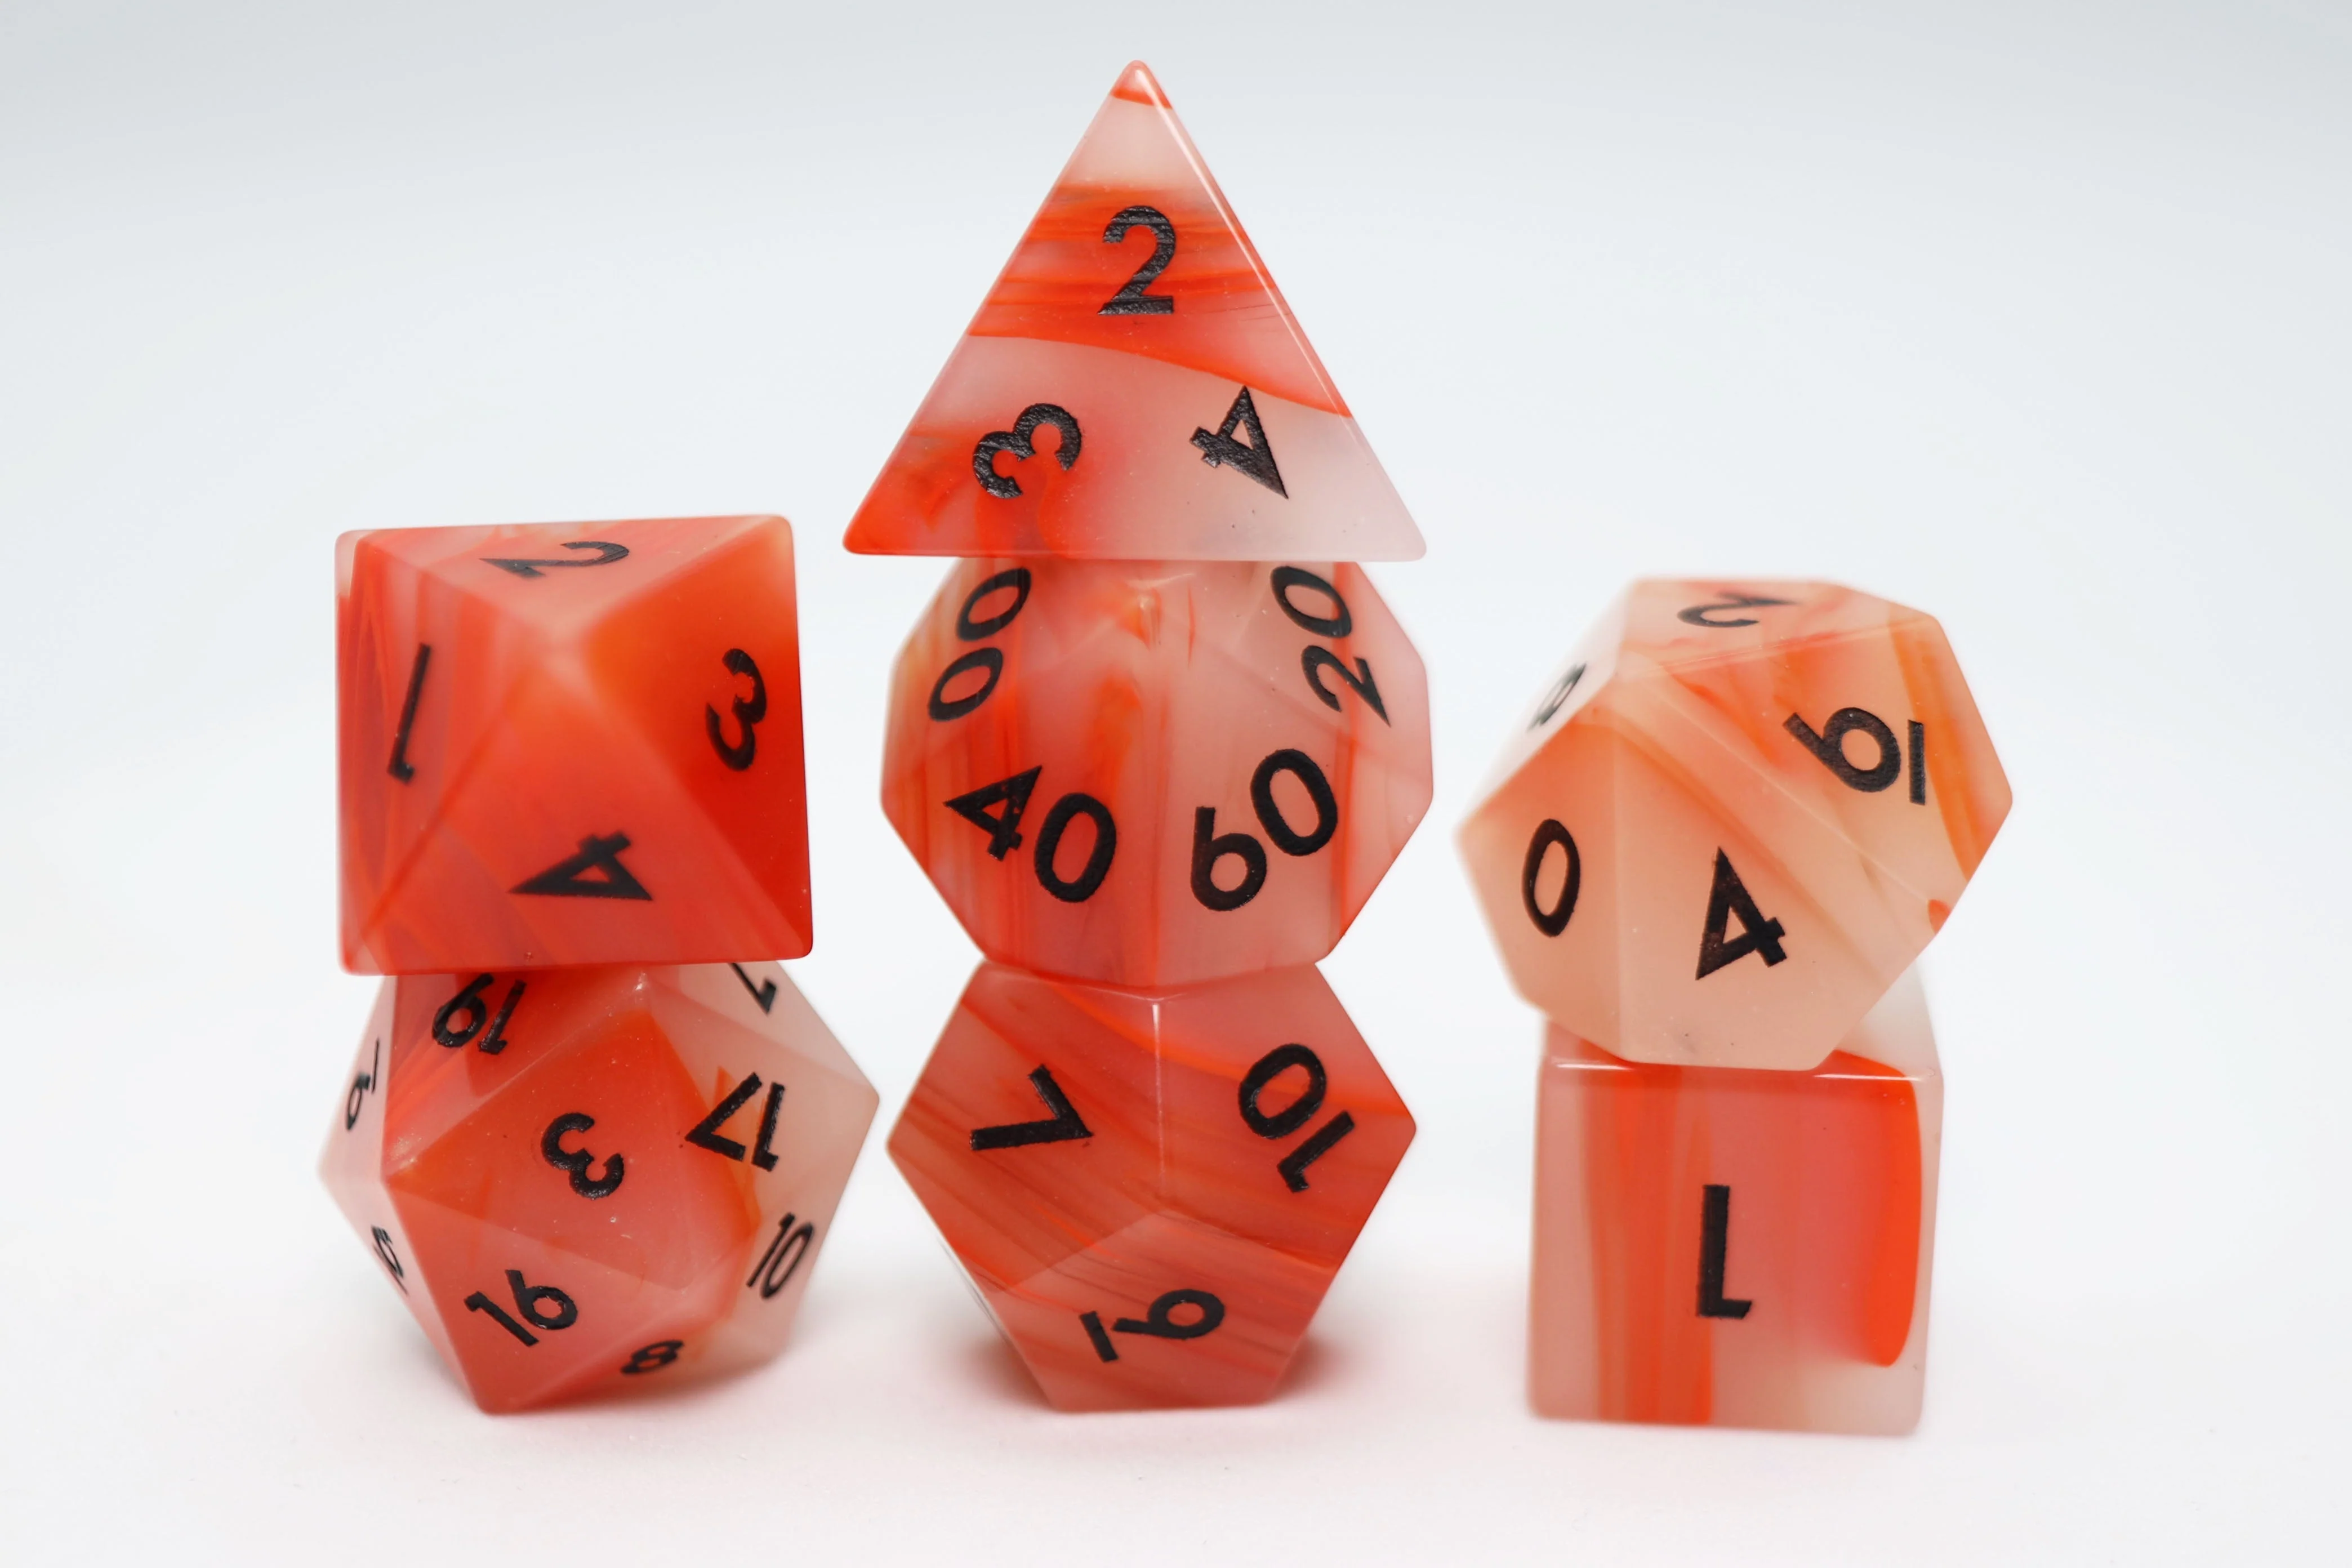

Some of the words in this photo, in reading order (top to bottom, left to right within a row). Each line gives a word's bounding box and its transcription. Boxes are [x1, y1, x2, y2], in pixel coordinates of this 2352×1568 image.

[1098, 205, 1176, 315] 2
[972, 403, 1083, 498] 3
[1190, 385, 1289, 499] 4
[479, 541, 630, 579] 2
[1677, 591, 1798, 627] 2
[928, 567, 1032, 721] 00
[1271, 565, 1391, 727] 20
[387, 644, 431, 784] 1
[706, 648, 767, 771] 3
[507, 831, 653, 901] 4
[944, 765, 1117, 904] 40
[1191, 749, 1338, 912] 60
[1522, 819, 1581, 937] 0
[1695, 847, 1787, 980] 4
[431, 972, 528, 1055] 19
[541, 1112, 625, 1200] 3
[685, 1072, 786, 1172] 17
[970, 1064, 1094, 1151] 7
[1239, 1044, 1356, 1193] 10
[747, 1213, 814, 1299] 10
[1696, 1184, 1753, 1320] 1
[464, 1269, 578, 1347] 16
[620, 1340, 684, 1375] 8
